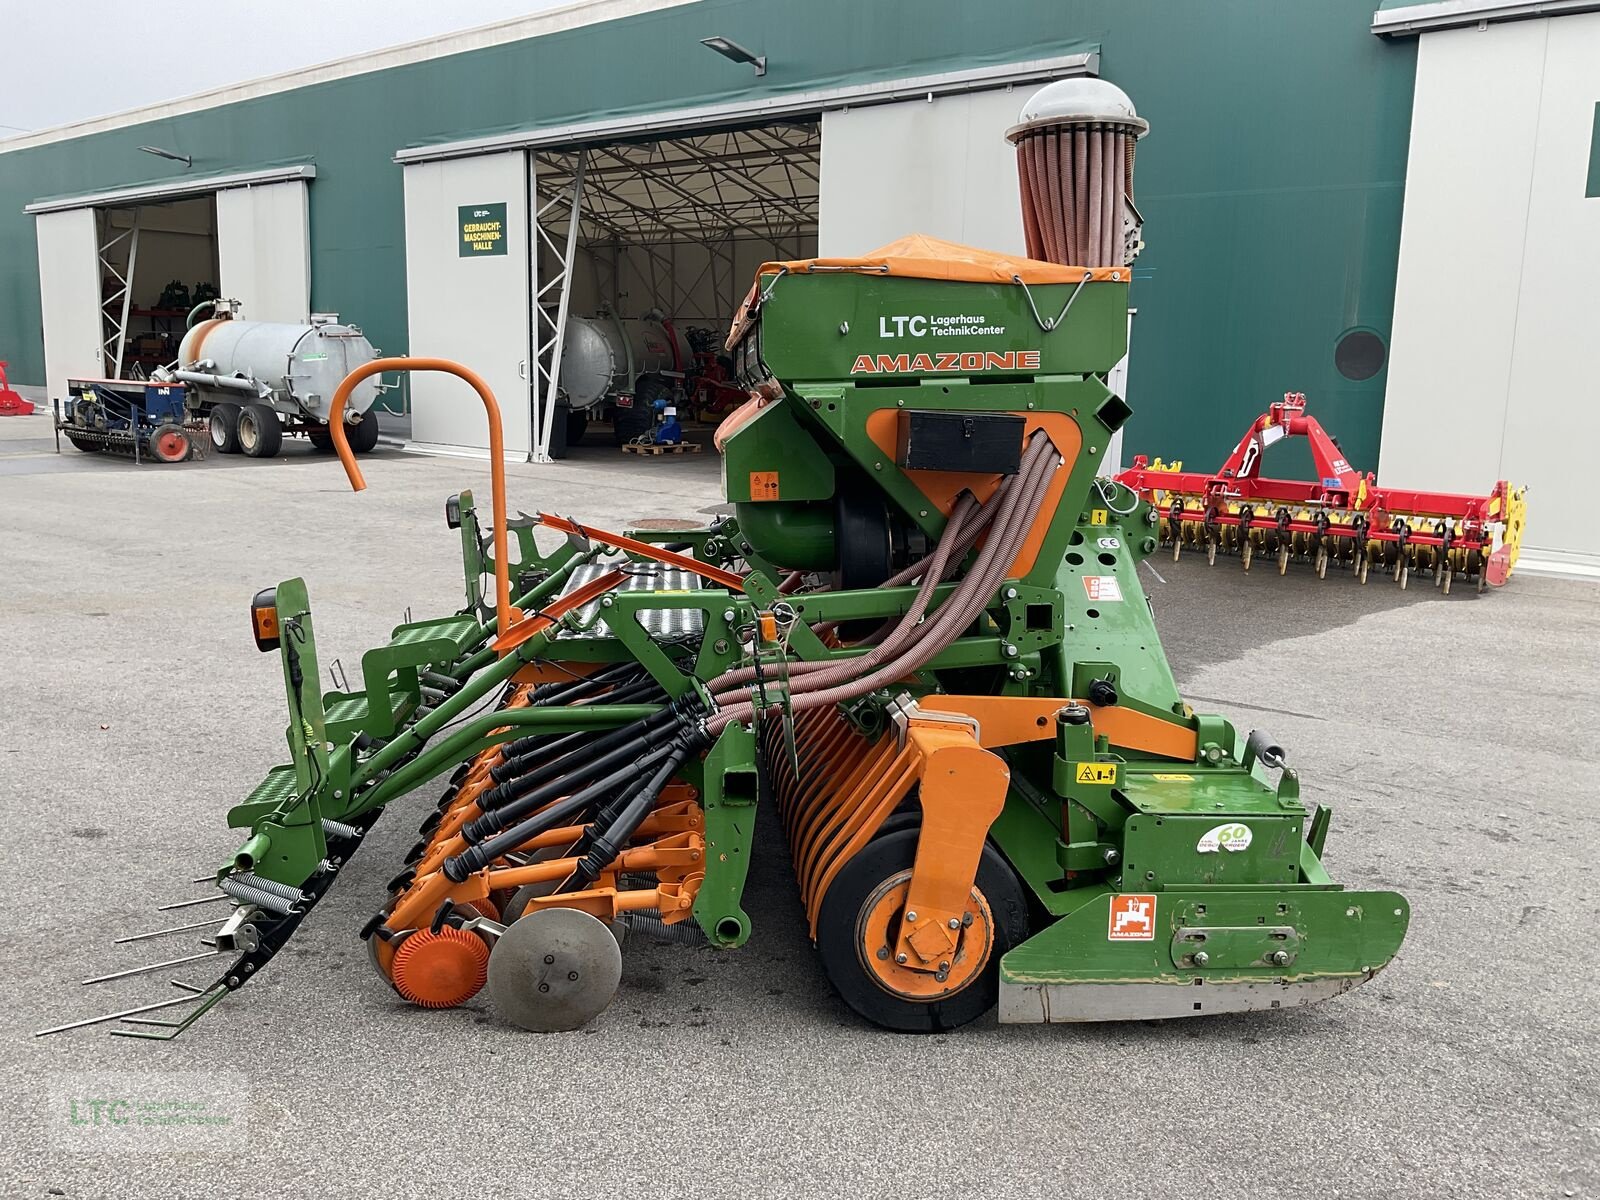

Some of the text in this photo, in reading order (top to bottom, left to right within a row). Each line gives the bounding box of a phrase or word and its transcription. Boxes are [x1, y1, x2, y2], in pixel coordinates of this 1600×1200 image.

[463, 221, 502, 233] GEBRAUCHT-
[463, 231, 502, 242] MASCHINEN-
[473, 241, 493, 251] HALLE
[879, 314, 985, 338] LTC Lagerhaus
[931, 326, 1005, 337] TechnikCenter
[850, 350, 1041, 375] AMAZONE
[1217, 825, 1247, 843] 60
